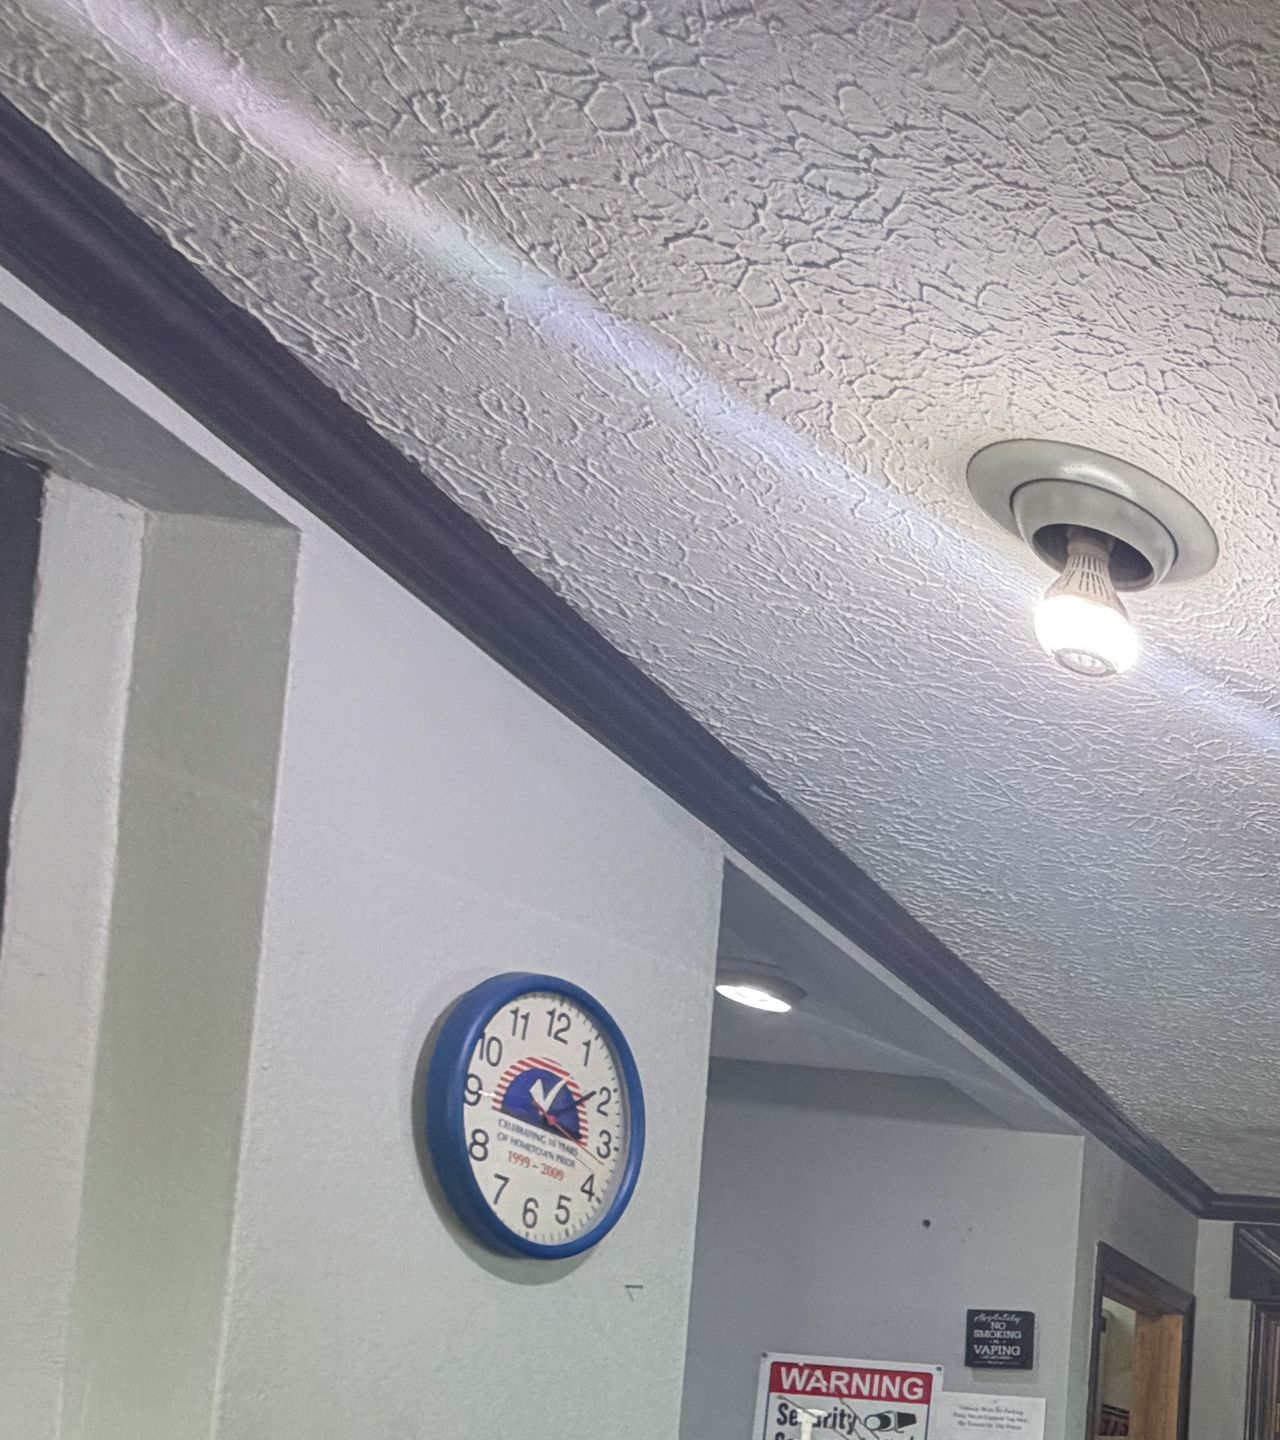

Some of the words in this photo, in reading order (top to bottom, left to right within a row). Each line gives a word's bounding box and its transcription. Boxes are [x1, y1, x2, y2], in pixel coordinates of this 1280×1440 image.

[510, 1006, 531, 1041] 11
[546, 1008, 572, 1045] 12
[478, 1032, 503, 1067] 10
[582, 1039, 591, 1066] 1
[463, 1073, 483, 1106] 9
[597, 1086, 612, 1117] 2
[469, 1128, 489, 1162] 8
[508, 1150, 531, 1168] 1999
[596, 1130, 612, 1159] 3
[494, 1173, 509, 1205] 7
[580, 1173, 595, 1202] 4
[522, 1198, 539, 1229] 6
[555, 1195, 572, 1225] 5
[974, 1330, 1021, 1339] SMOKING
[990, 1321, 1006, 1330] NO
[973, 1344, 1021, 1356] VAPING
[780, 1366, 924, 1400] WARNING
